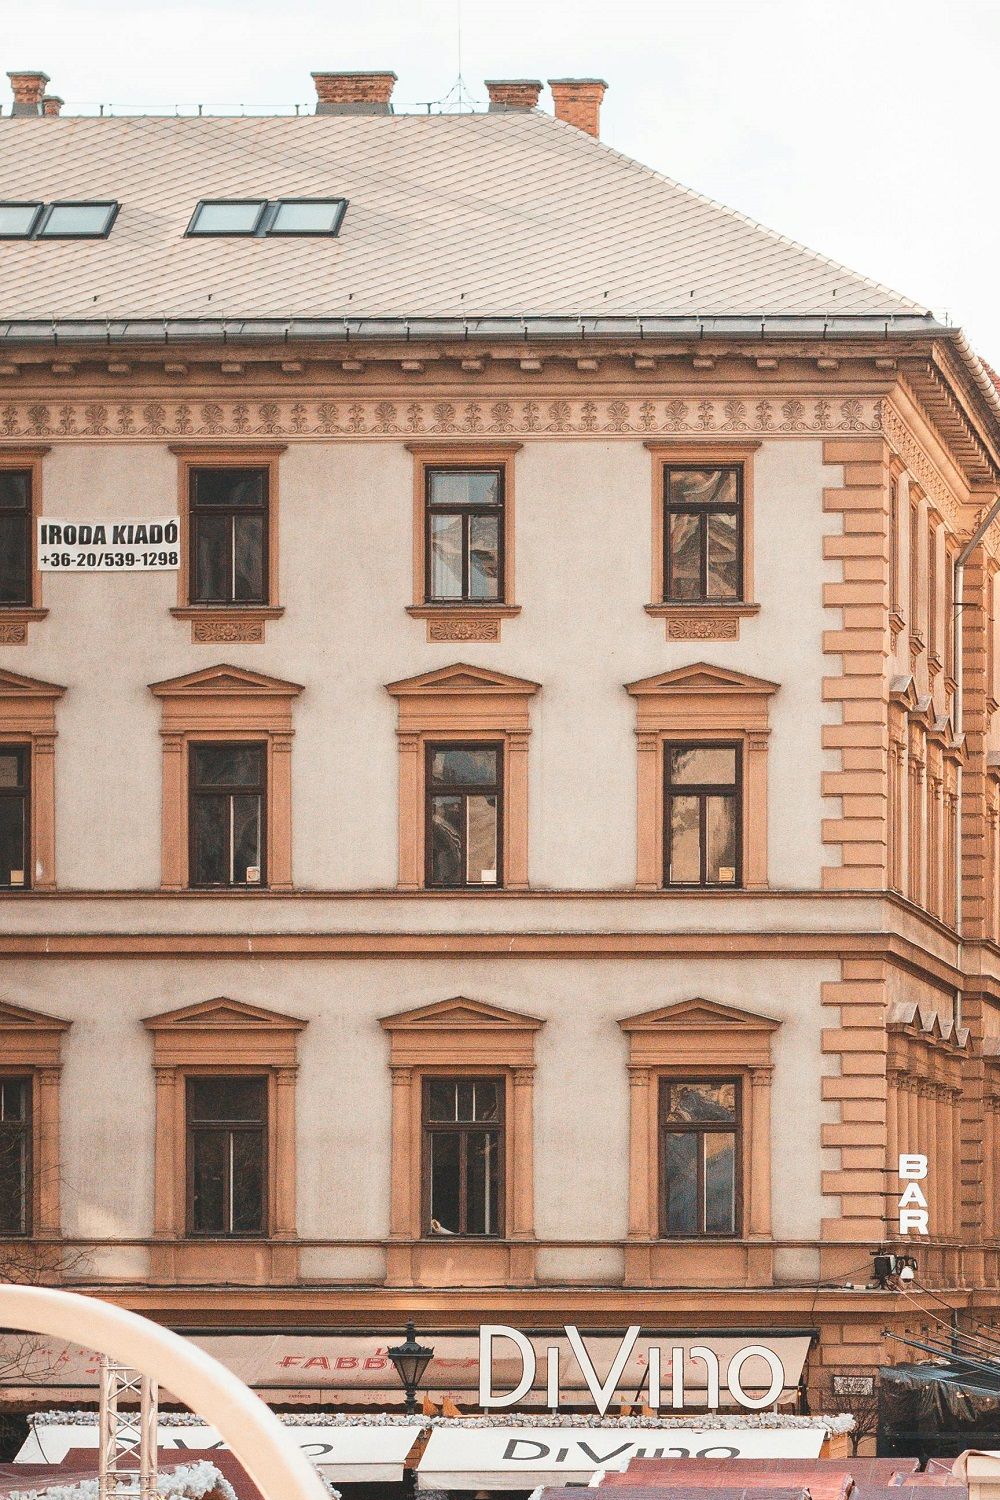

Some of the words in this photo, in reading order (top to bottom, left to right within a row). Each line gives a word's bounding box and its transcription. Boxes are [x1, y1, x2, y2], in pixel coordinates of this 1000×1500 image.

[41, 525, 107, 545] IRODA
[112, 520, 178, 545] KIADÓ
[41, 552, 178, 567] +36-20/539-1298
[898, 1153, 929, 1235] BAR
[479, 1324, 786, 1417] DiVino
